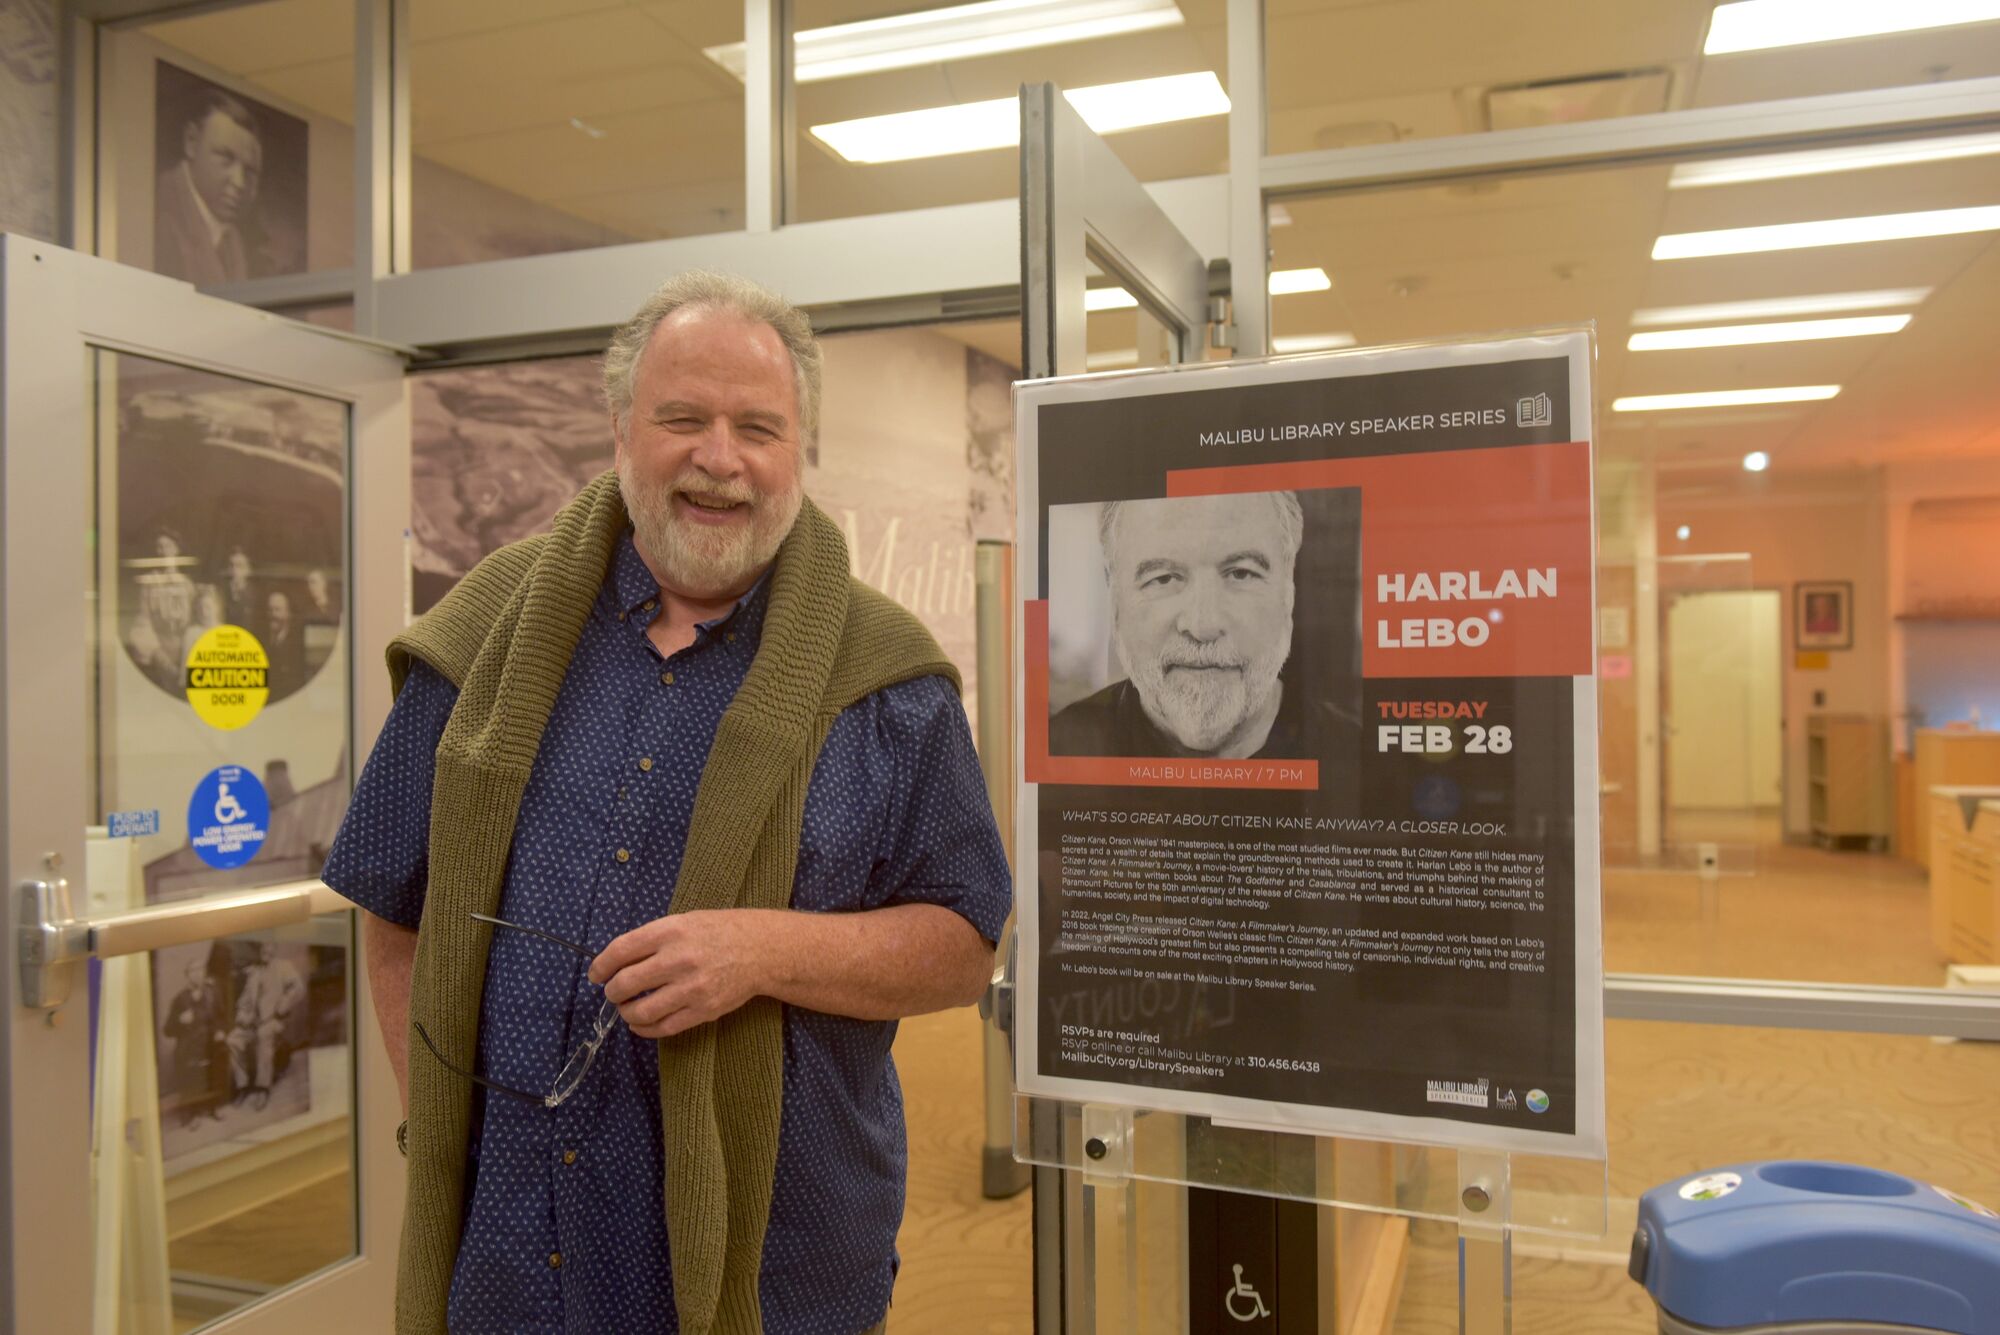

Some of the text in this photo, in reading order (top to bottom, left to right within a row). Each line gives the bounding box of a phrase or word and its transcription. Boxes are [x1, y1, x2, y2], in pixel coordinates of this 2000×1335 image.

[1200, 409, 1506, 446] MALIBU LIBRARY SPEAKER SERIES
[843, 510, 977, 615] Malib
[1378, 568, 1557, 601] HARLAN
[1378, 618, 1489, 647] LEBO
[195, 650, 260, 662] AUTOMATIC
[191, 668, 265, 687] CAUTION
[211, 694, 245, 705] DOOR
[1378, 702, 1487, 717] TUESDAY
[1379, 726, 1512, 752] FEB 28
[1129, 766, 1185, 779] MALIBU
[1190, 767, 1253, 779] LIBRARY
[1280, 768, 1303, 780] PM
[1062, 811, 1107, 822] WHAT'S
[1110, 812, 1128, 822] SO
[1130, 812, 1172, 824] GREAT
[1172, 814, 1220, 825] ABOUT
[1221, 815, 1272, 827] CITIZEN
[1276, 817, 1313, 829] KANE
[1315, 818, 1384, 831] ANYWAY?
[1400, 821, 1459, 834] CLOSER
[1462, 822, 1506, 836] LOOK.
[1061, 834, 1086, 843] Citizen
[1109, 836, 1132, 845] Orson
[1160, 838, 1176, 847] 1941
[1253, 842, 1262, 850] of
[1262, 842, 1276, 851] the
[1277, 844, 1298, 852] most
[1300, 844, 1330, 853] studied
[1331, 844, 1352, 854] films
[1353, 847, 1371, 855] ever
[1401, 847, 1417, 857] But
[1418, 848, 1448, 858] Citizen
[1450, 849, 1473, 859] Kane
[1474, 850, 1490, 860] still
[1491, 851, 1517, 861] hides
[1518, 854, 1544, 863] many
[1062, 856, 1086, 864] Citizen
[1256, 865, 1284, 876] history
[1286, 866, 1295, 874] of
[1297, 867, 1310, 875] the
[1387, 871, 1404, 880] and
[1406, 872, 1445, 882] triumphs
[1447, 874, 1479, 883] behind
[1481, 875, 1496, 884] the
[1498, 876, 1532, 888] making
[1535, 877, 1545, 886] of
[1133, 892, 1148, 901] and
[1149, 893, 1162, 901] the
[1163, 893, 1190, 904] impact
[1191, 895, 1199, 903] of
[1200, 896, 1224, 906] digital
[1092, 912, 1113, 921] Angel
[1115, 913, 1130, 922] City
[1132, 914, 1153, 922] Press
[1155, 916, 1188, 925] released
[1189, 917, 1215, 926] Citizen
[1345, 928, 1380, 937] updated
[1382, 930, 1399, 939] and
[1401, 932, 1444, 941] expanded
[1446, 934, 1468, 942] work
[1470, 934, 1498, 944] based
[1062, 941, 1091, 951] freedom
[1108, 947, 1141, 955] recounts
[1158, 948, 1167, 956] of
[1168, 949, 1181, 958] the
[1182, 951, 1201, 959] most
[1202, 953, 1233, 964] exciting
[1233, 954, 1269, 964] chapters
[1270, 956, 1278, 964] in
[1280, 957, 1323, 968] Hollywood
[1099, 966, 1118, 975] book
[1119, 968, 1132, 976] will
[1133, 968, 1144, 977] be
[1156, 971, 1173, 979] sale
[1173, 972, 1181, 980] at
[1183, 972, 1196, 981] the
[1197, 973, 1223, 984] Malibu
[1225, 976, 1253, 988] Library
[1254, 978, 1287, 988] Speaker
[1061, 1025, 1160, 1043] RSVPs are required
[1061, 1051, 1225, 1076] MalibuCity.org/LibrarySpeakers
[1062, 1038, 1089, 1048] RSVP
[1091, 1042, 1123, 1052] online
[1158, 1048, 1193, 1059] Malibu
[1195, 1052, 1232, 1065] Library
[1235, 1057, 1245, 1065] at
[1248, 1056, 1320, 1072] 310.456.6438
[1427, 1080, 1489, 1096] MALIBU LIBRARY
